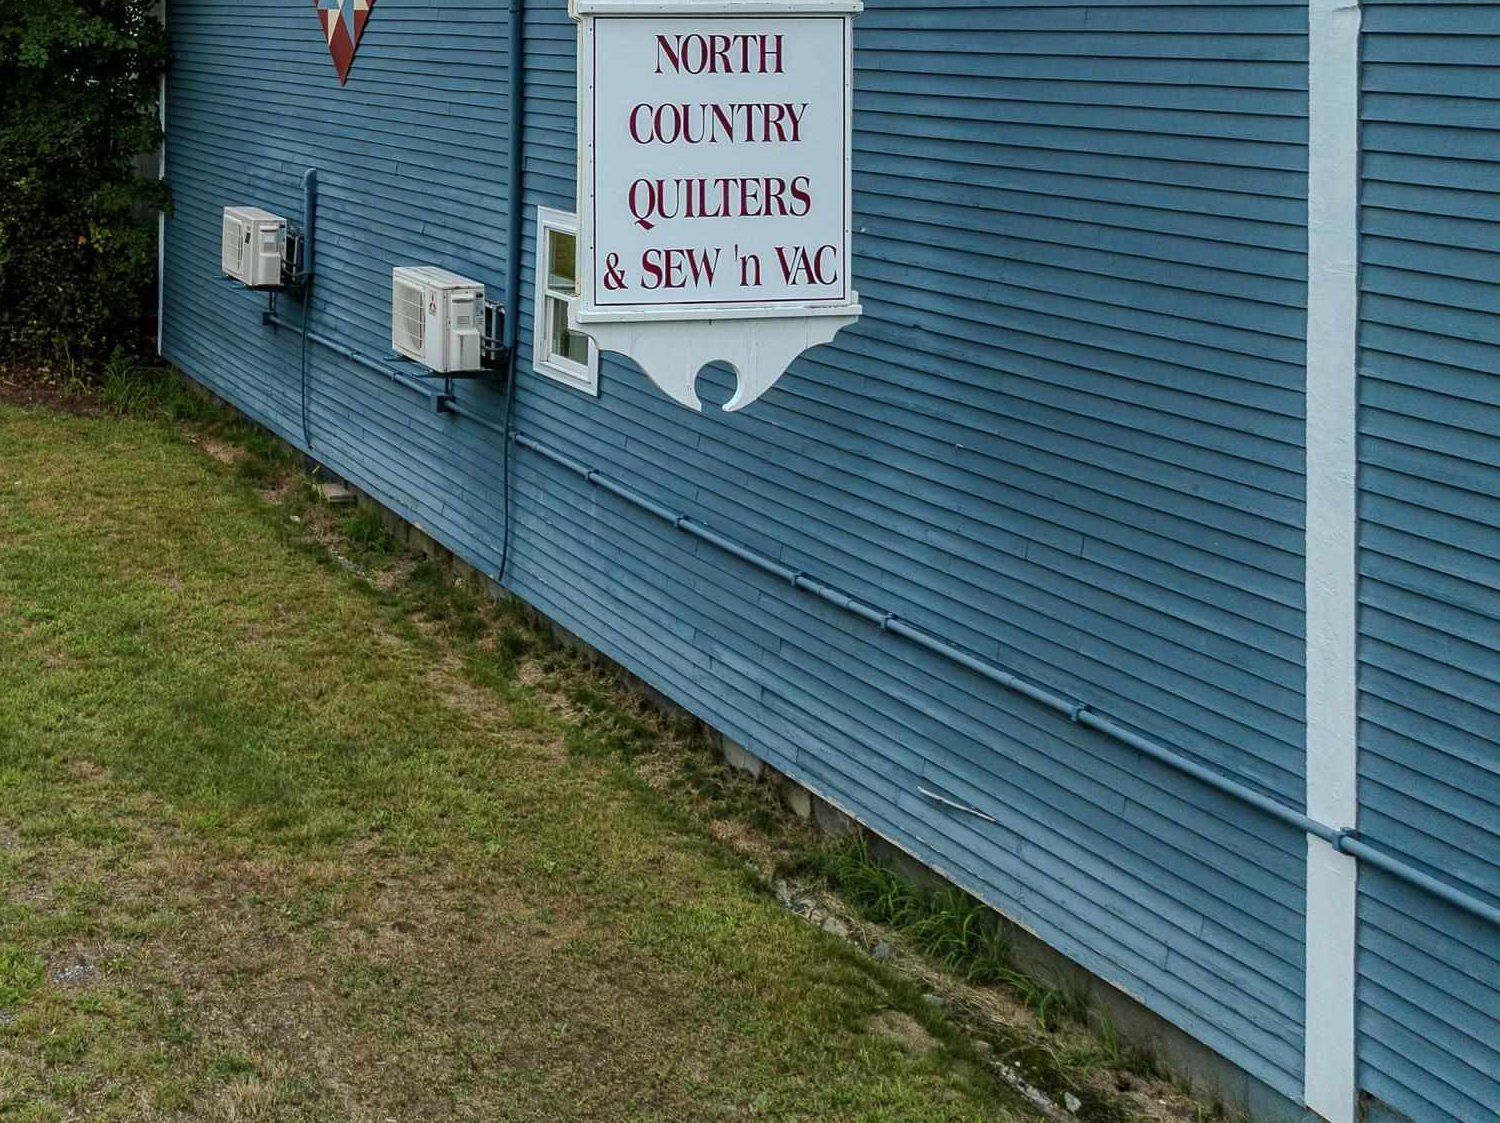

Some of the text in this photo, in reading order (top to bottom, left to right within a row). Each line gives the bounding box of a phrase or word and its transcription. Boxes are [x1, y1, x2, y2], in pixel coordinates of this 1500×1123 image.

[655, 34, 784, 74] NORTH
[629, 103, 808, 144] COUNTRY
[628, 176, 811, 230] QUILTERS
[603, 243, 837, 290] & SEW 'n VAC
